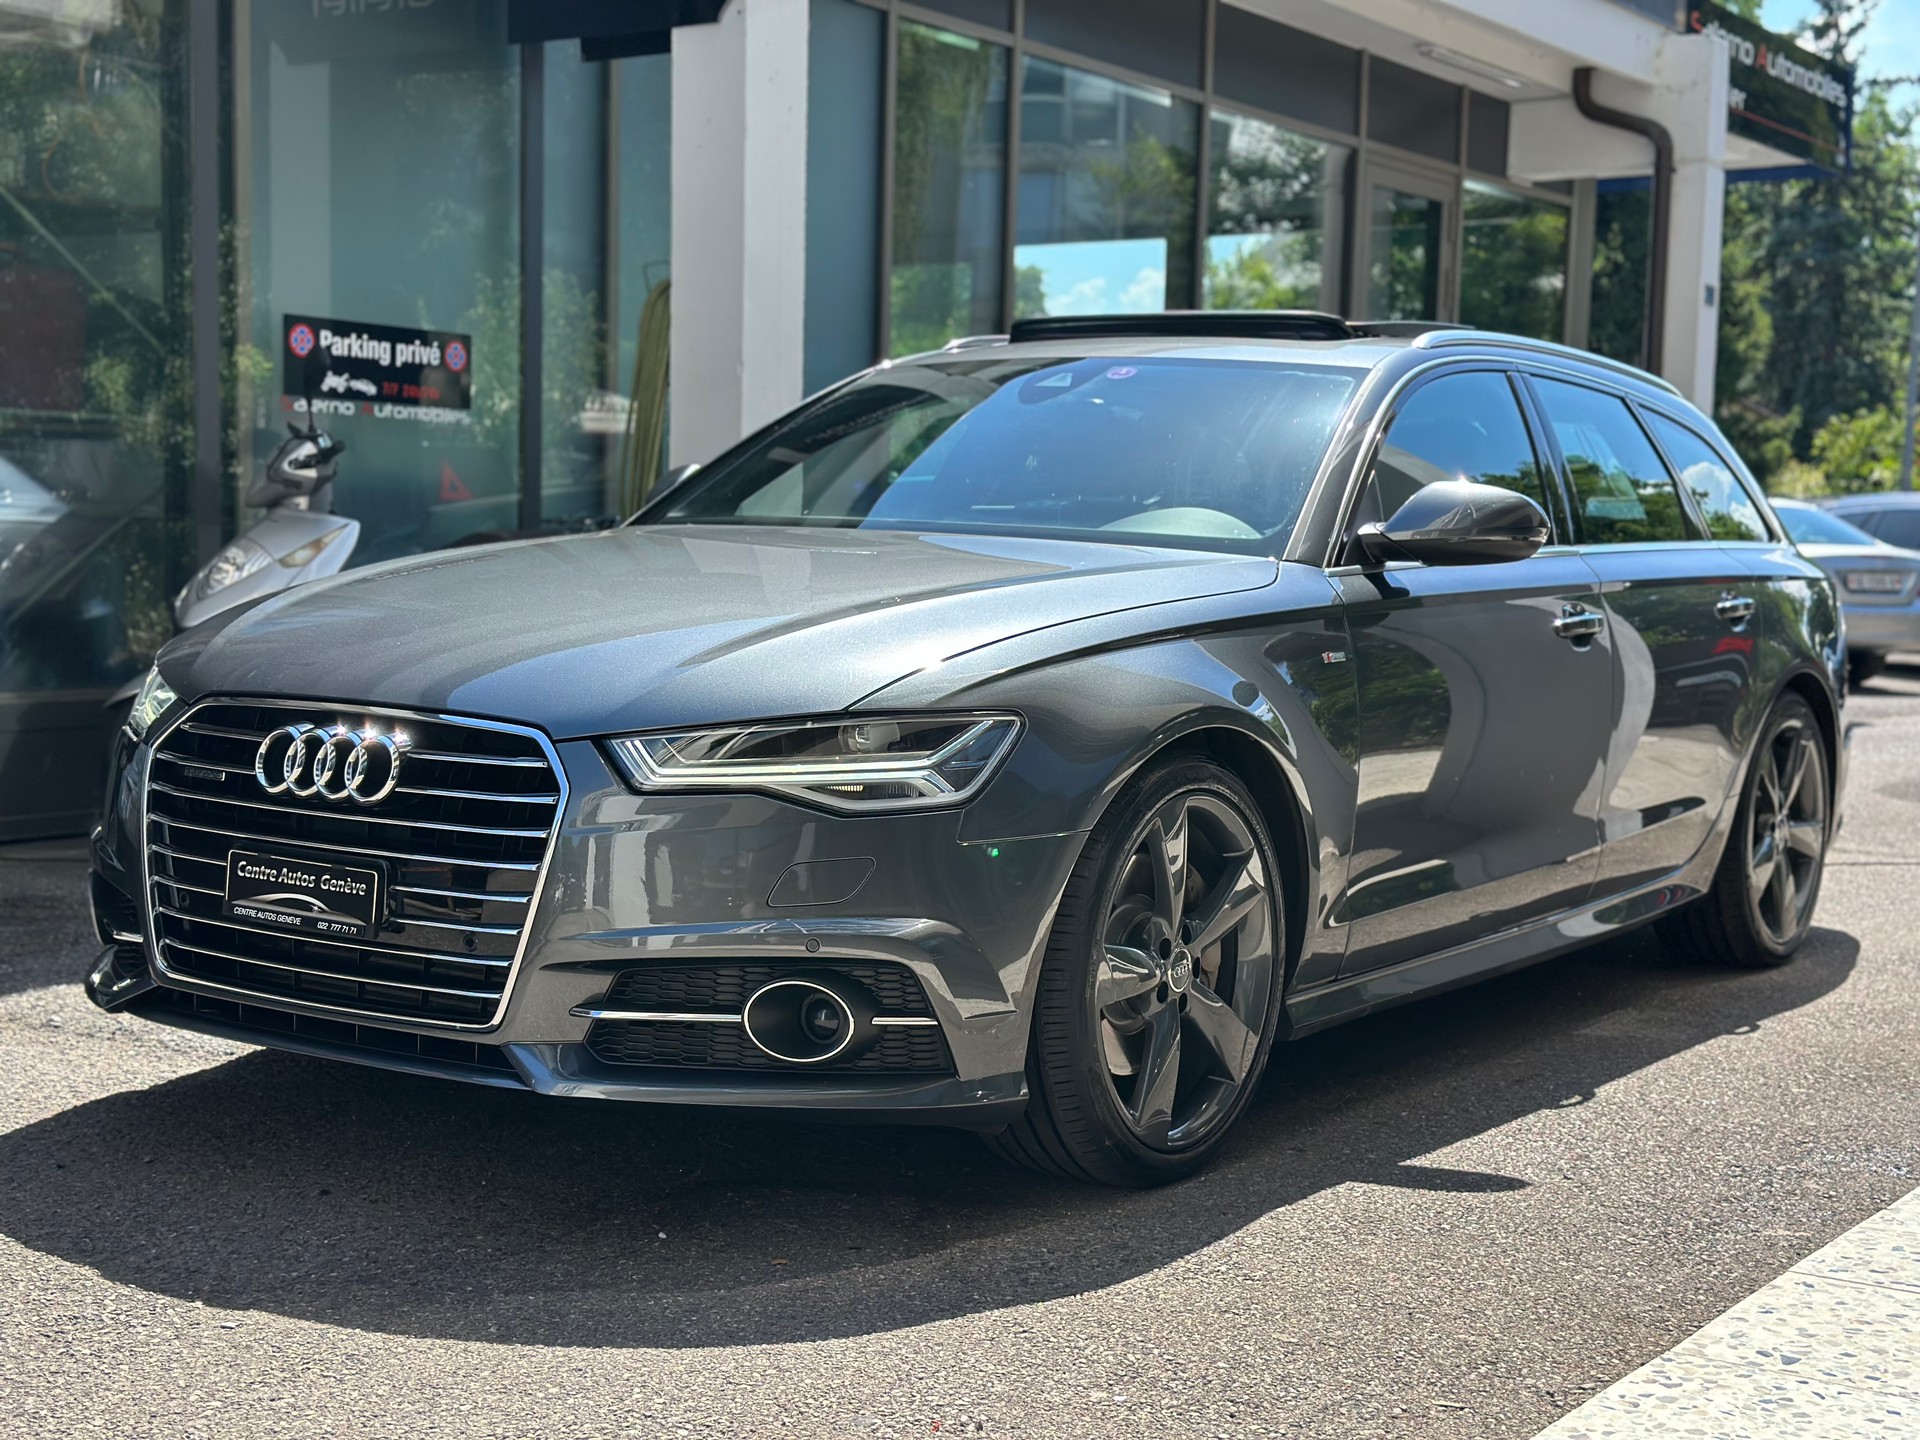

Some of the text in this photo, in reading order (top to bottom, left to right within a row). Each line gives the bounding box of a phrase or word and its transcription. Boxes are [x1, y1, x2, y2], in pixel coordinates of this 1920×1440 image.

[319, 329, 441, 367] Parking privé
[280, 395, 355, 416] Saerno
[237, 861, 367, 896] Centre Autos Genève
[234, 907, 301, 925] CENTRE AUTOS GENEVE
[317, 921, 357, 935] 022 777 71 71
